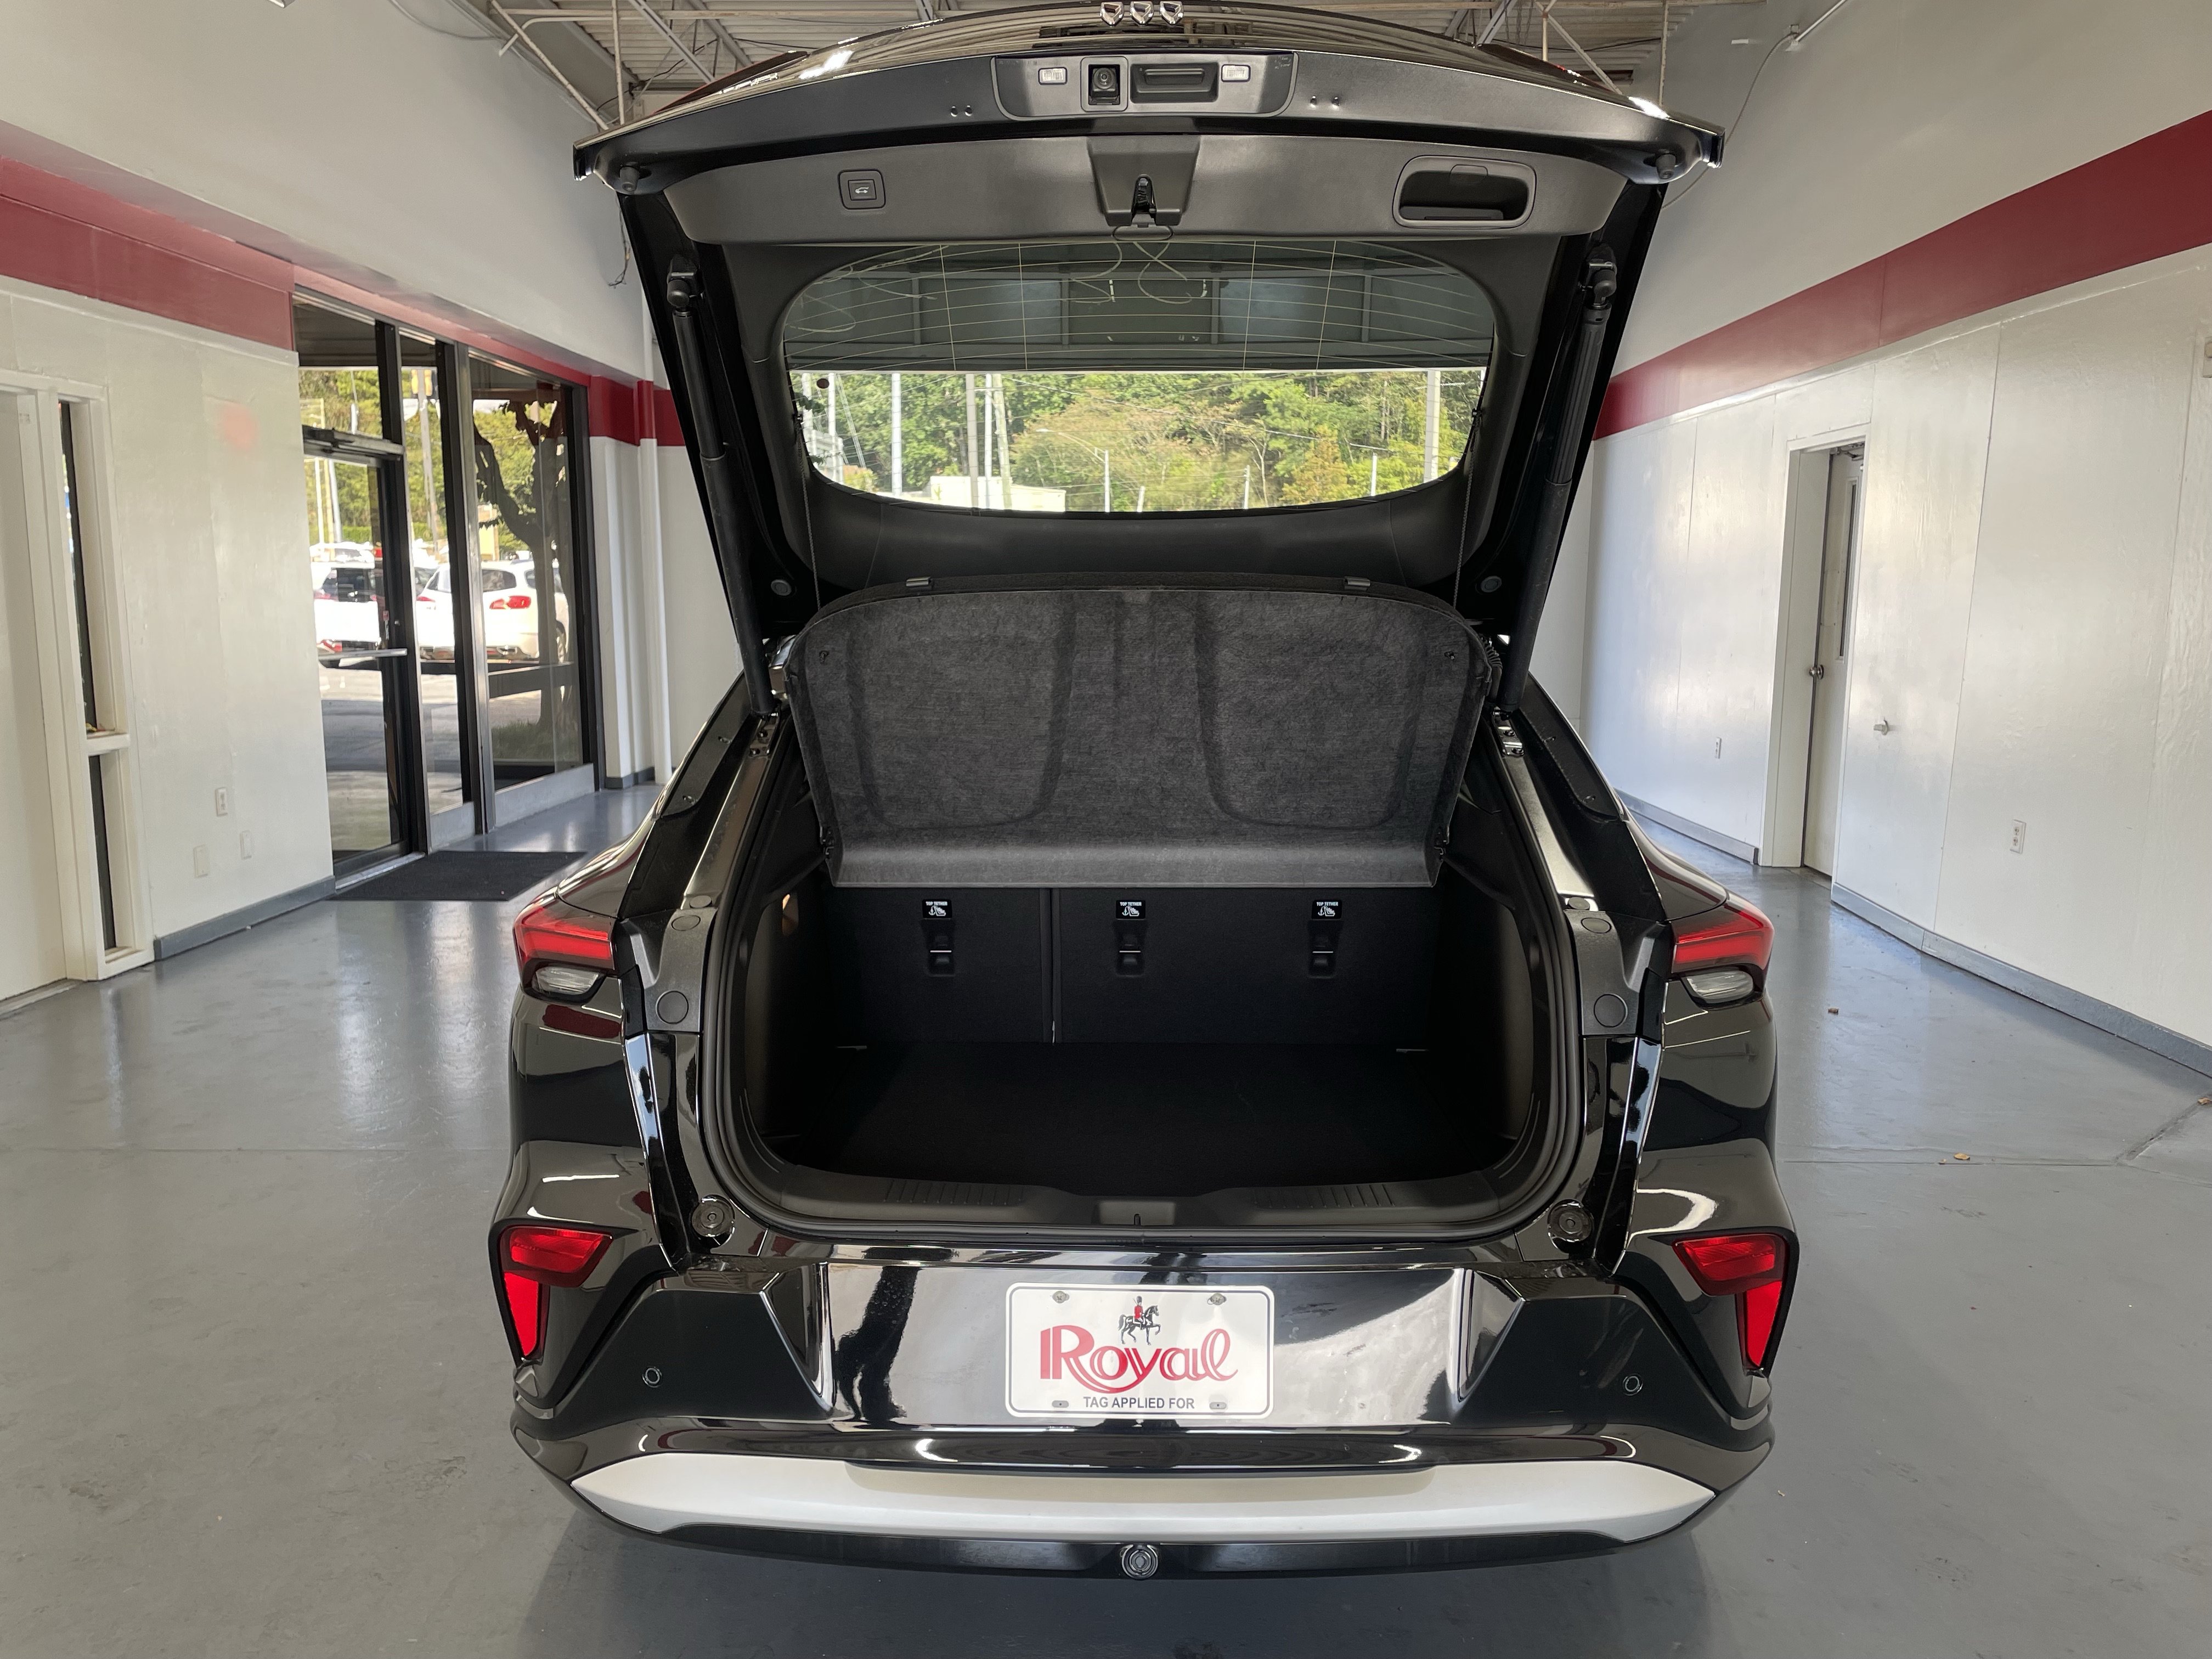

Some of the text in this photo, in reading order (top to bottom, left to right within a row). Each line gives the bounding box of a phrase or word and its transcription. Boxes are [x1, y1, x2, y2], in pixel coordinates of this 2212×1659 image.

[1040, 1325, 1238, 1393] Royal
[1083, 1396, 1195, 1409] TAG APPLIED FOR
